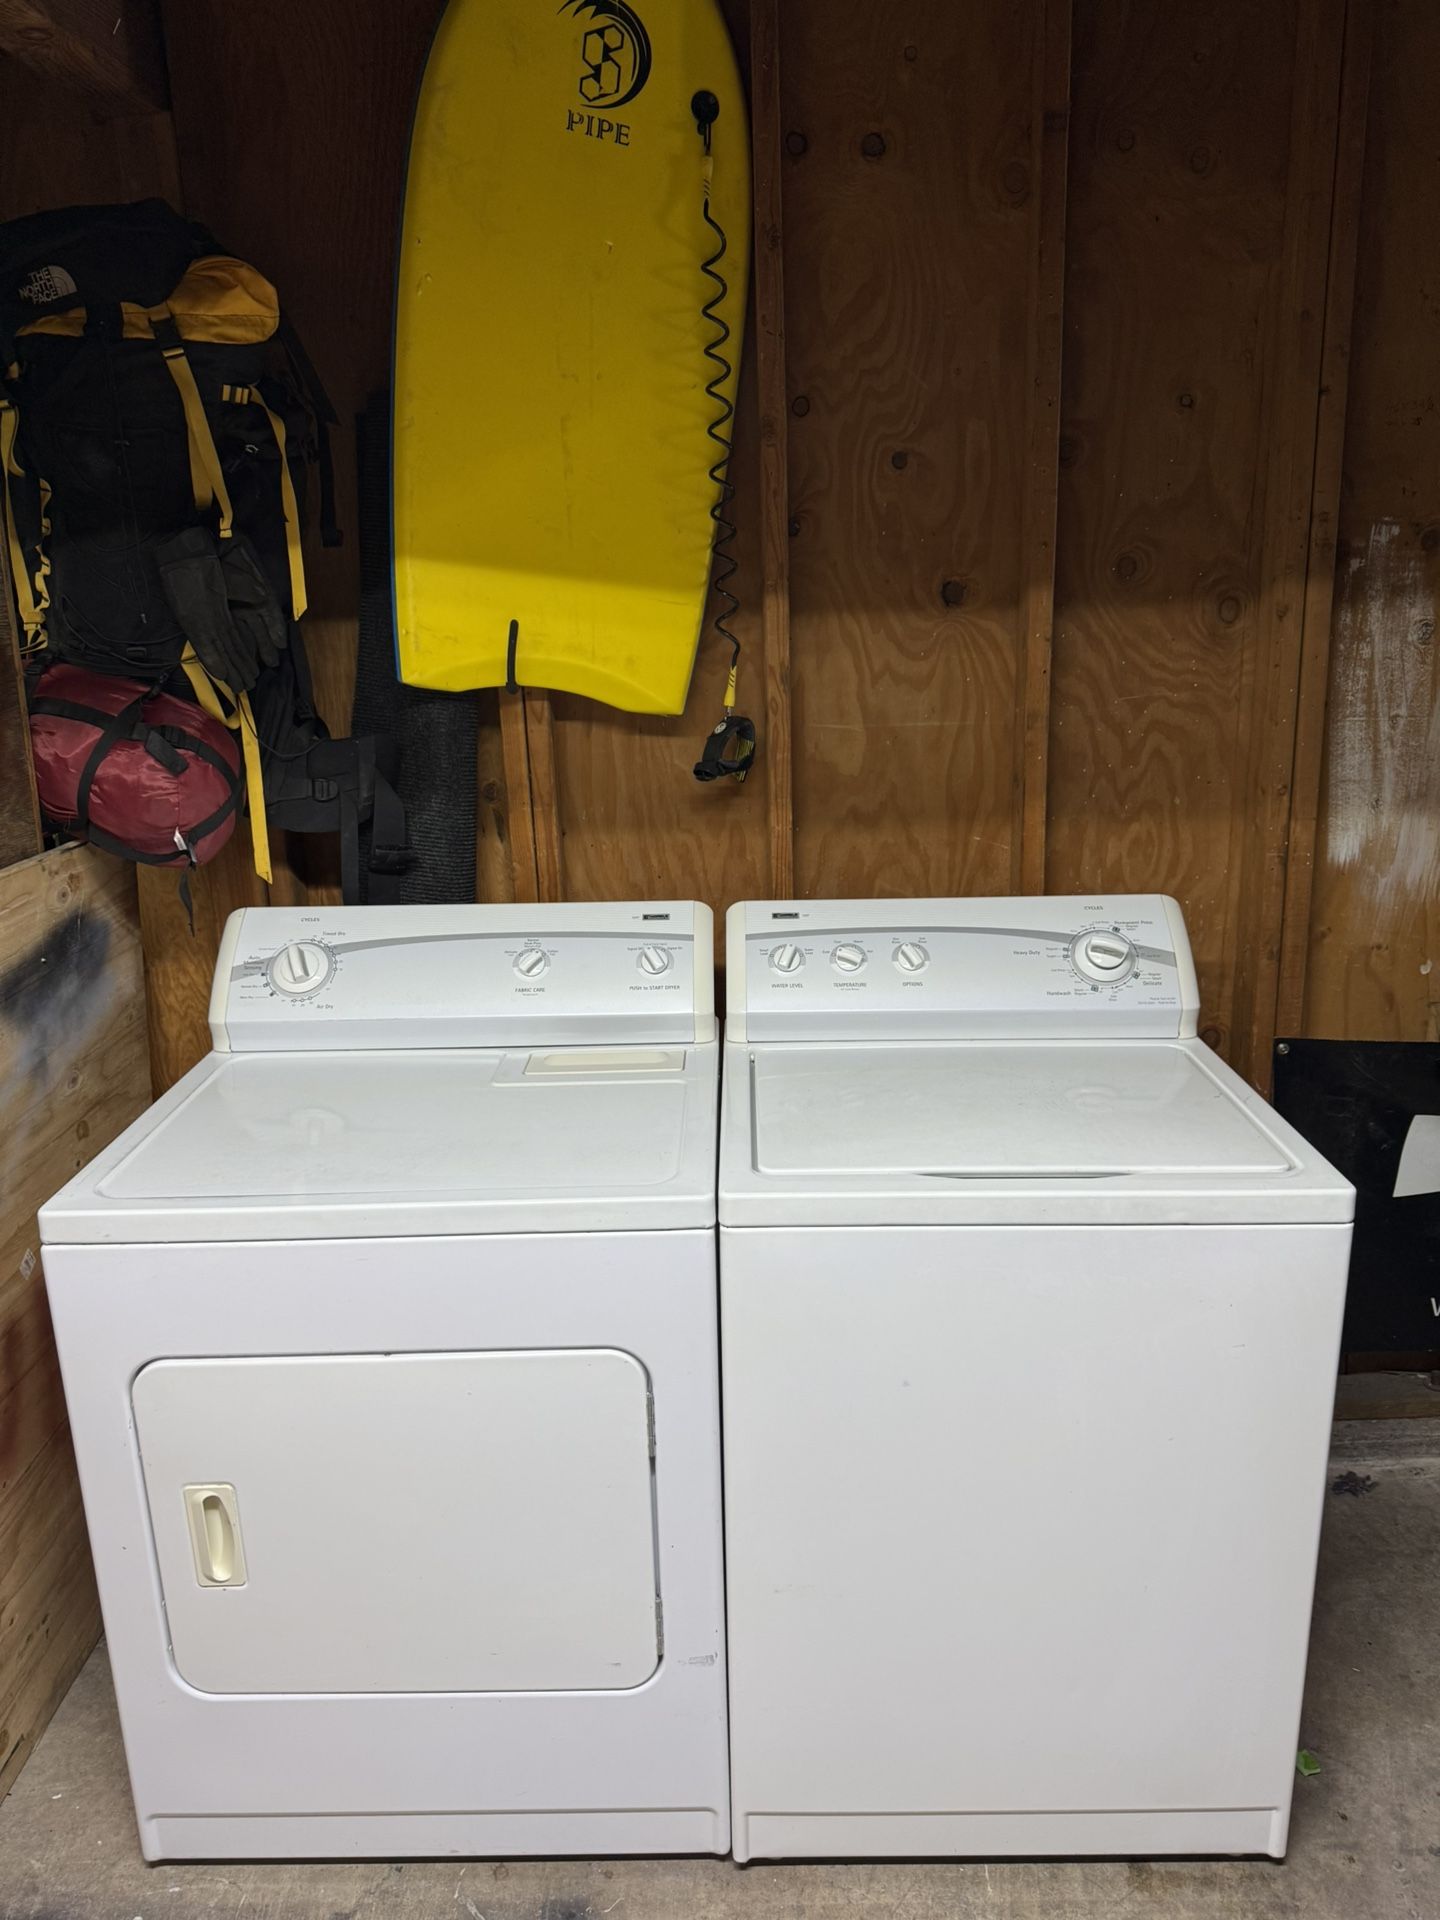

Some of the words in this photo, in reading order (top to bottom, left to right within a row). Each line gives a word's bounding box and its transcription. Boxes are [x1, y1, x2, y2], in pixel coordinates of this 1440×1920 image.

[566, 109, 631, 147] PIPE
[27, 267, 51, 283] THE
[18, 279, 54, 300] NORTH
[32, 289, 59, 304] FACE
